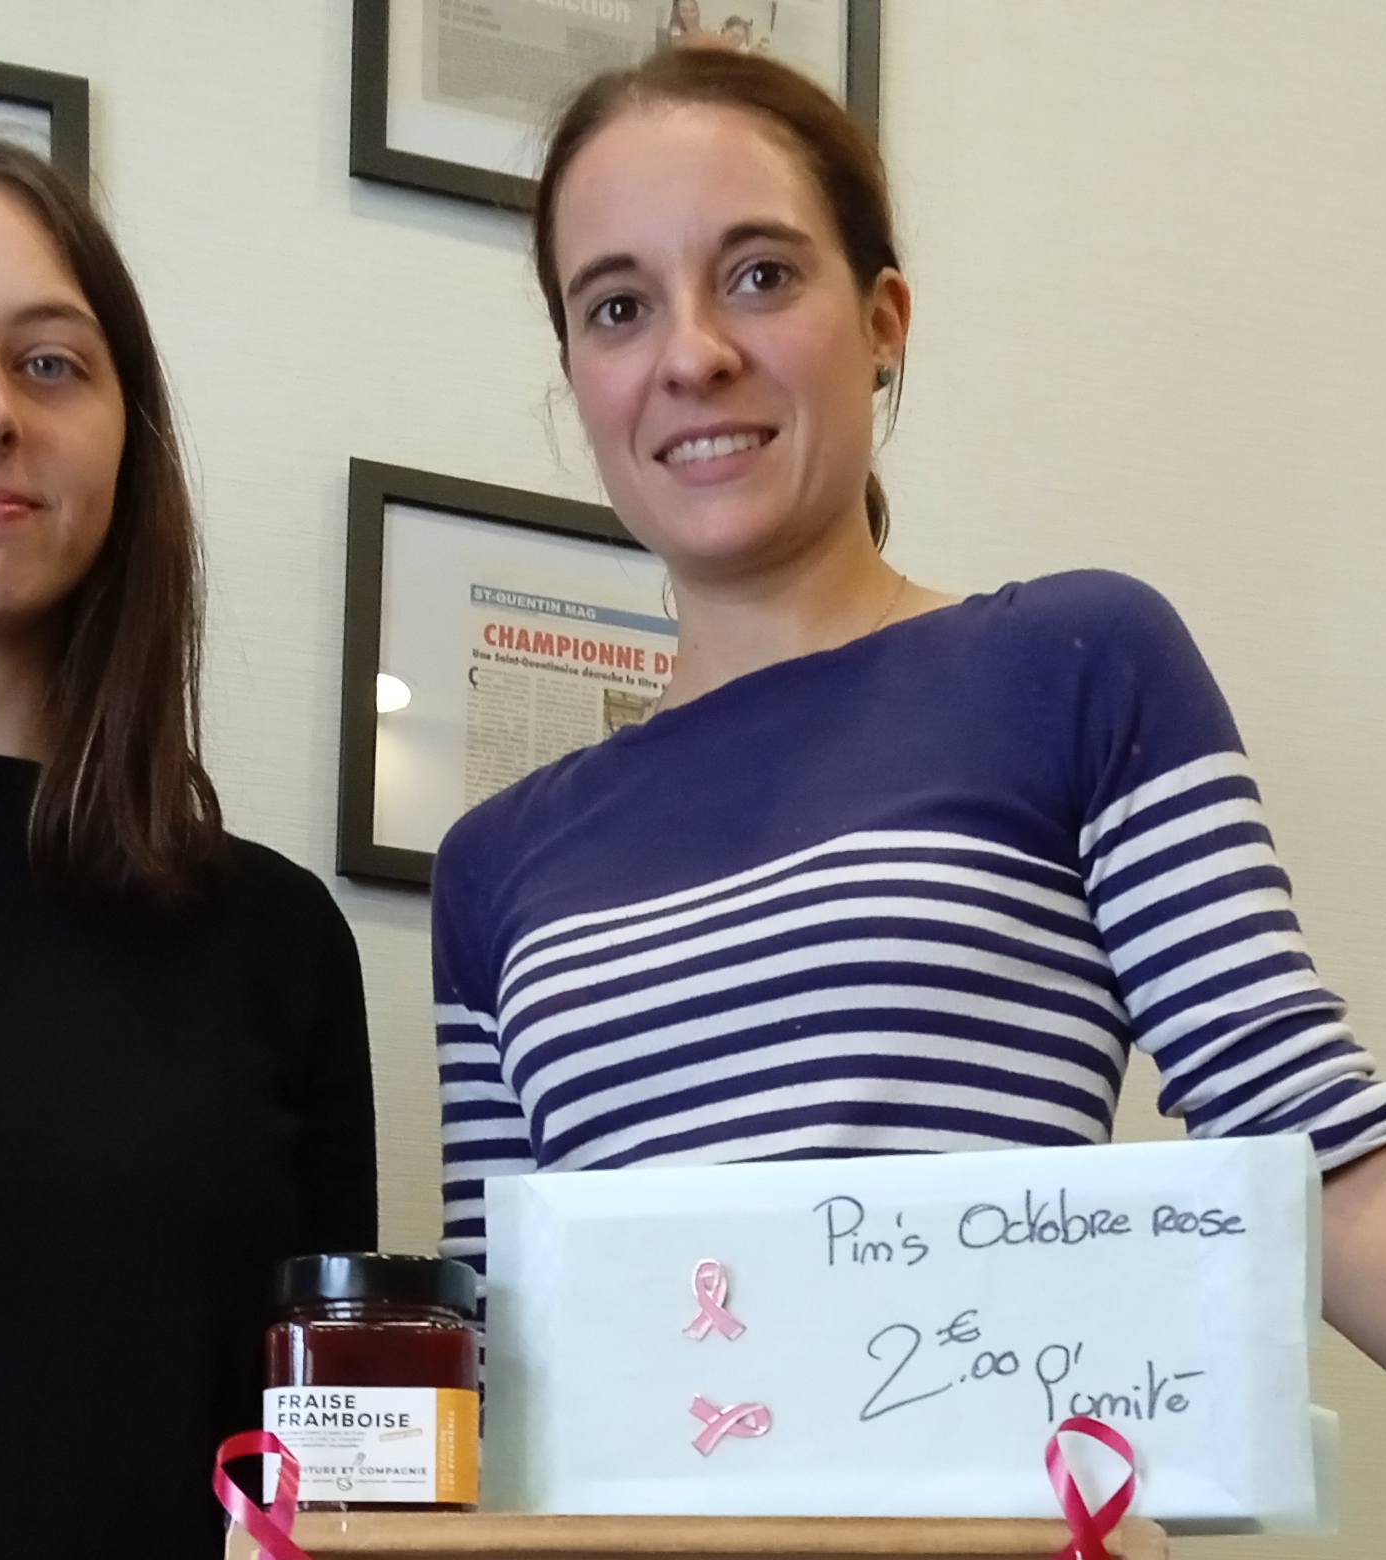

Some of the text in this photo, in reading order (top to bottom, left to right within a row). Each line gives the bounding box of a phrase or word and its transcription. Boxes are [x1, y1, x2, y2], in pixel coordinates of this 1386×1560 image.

[472, 587, 597, 620] ST-QUENTIN MAG
[472, 647, 492, 661] Une
[483, 623, 645, 672] CHAMPIONNE
[277, 1393, 356, 1410] FRAISE
[277, 1412, 411, 1429] FRAMBOISE
[358, 1466, 428, 1477] COMPAGNIE
